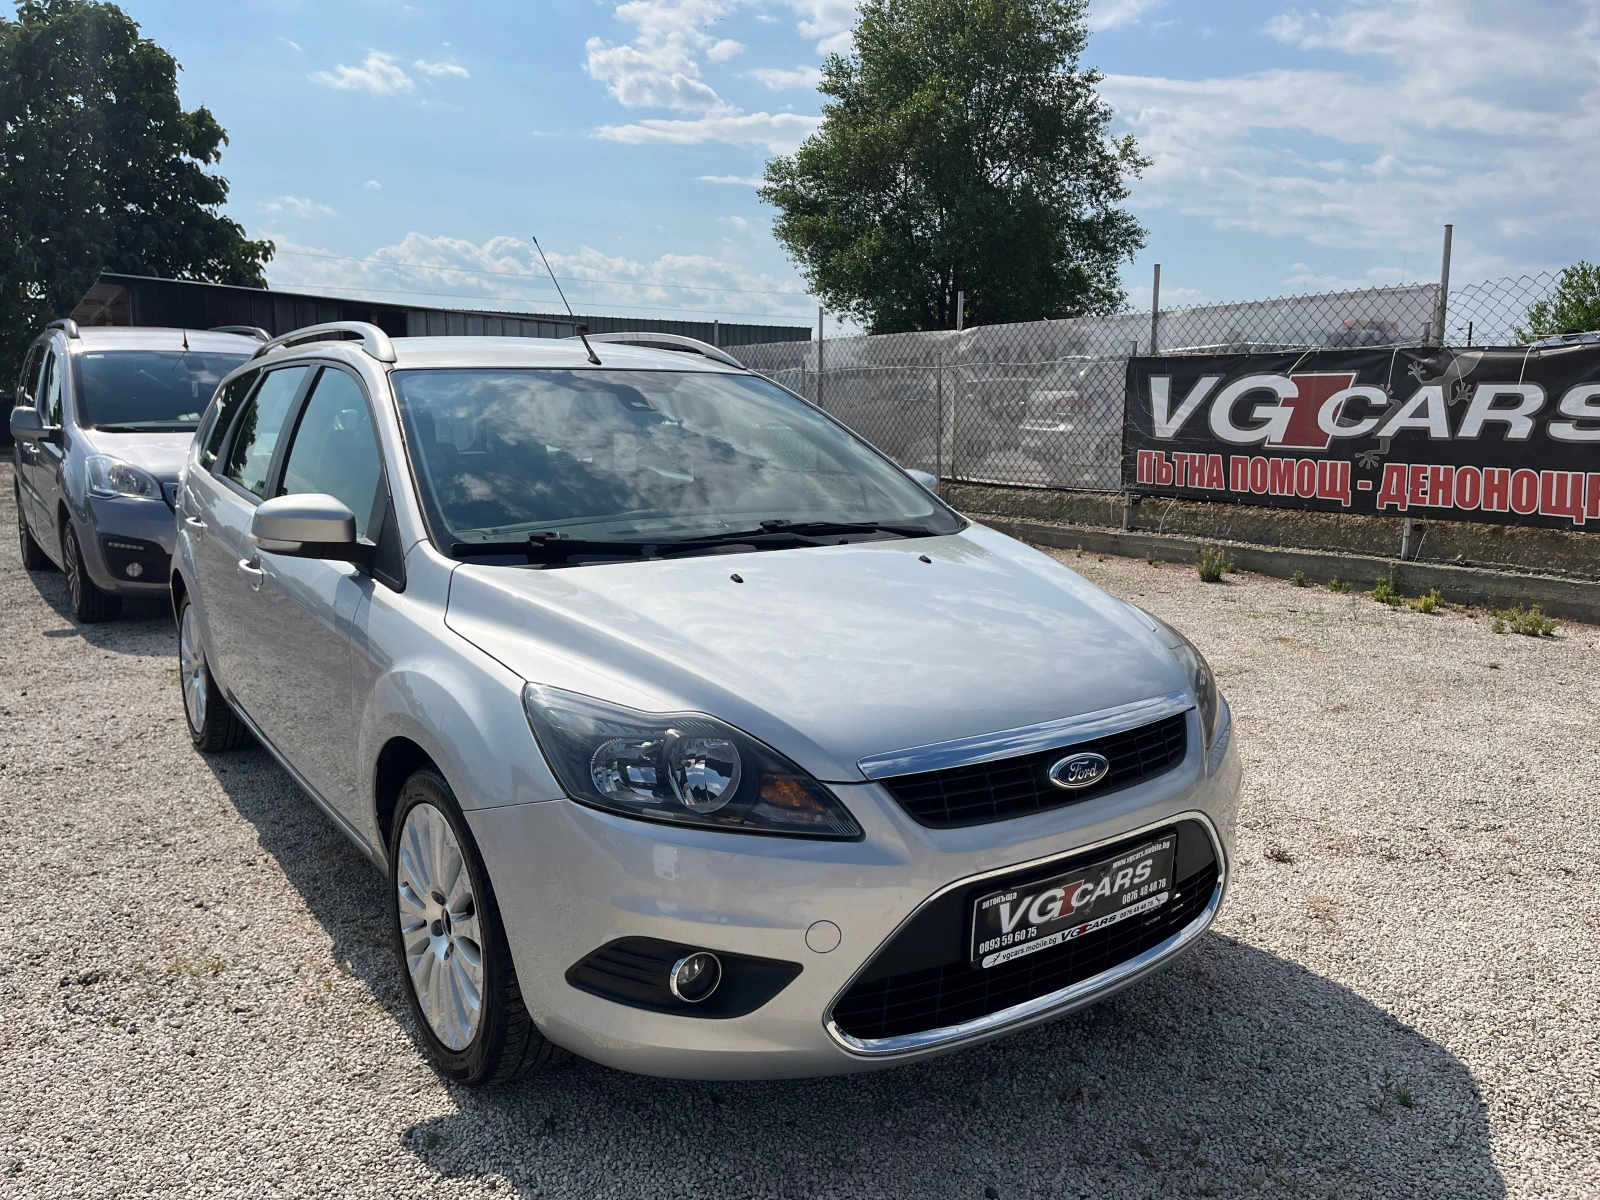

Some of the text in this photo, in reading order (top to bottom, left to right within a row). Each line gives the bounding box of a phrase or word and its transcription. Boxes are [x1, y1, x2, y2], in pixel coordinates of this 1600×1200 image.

[1136, 450, 1225, 490] ПЪТНА
[1230, 456, 1352, 507] ПОМОЩ
[1067, 760, 1098, 782] Ford
[1112, 841, 1171, 869] www.vgcars.mobile.bg
[981, 891, 1018, 910] автокъща
[1122, 878, 1167, 905] 0876 48 48 78
[979, 926, 1037, 955] 0893 59 60 75
[1002, 937, 1057, 960] vgcars.mobile.bg
